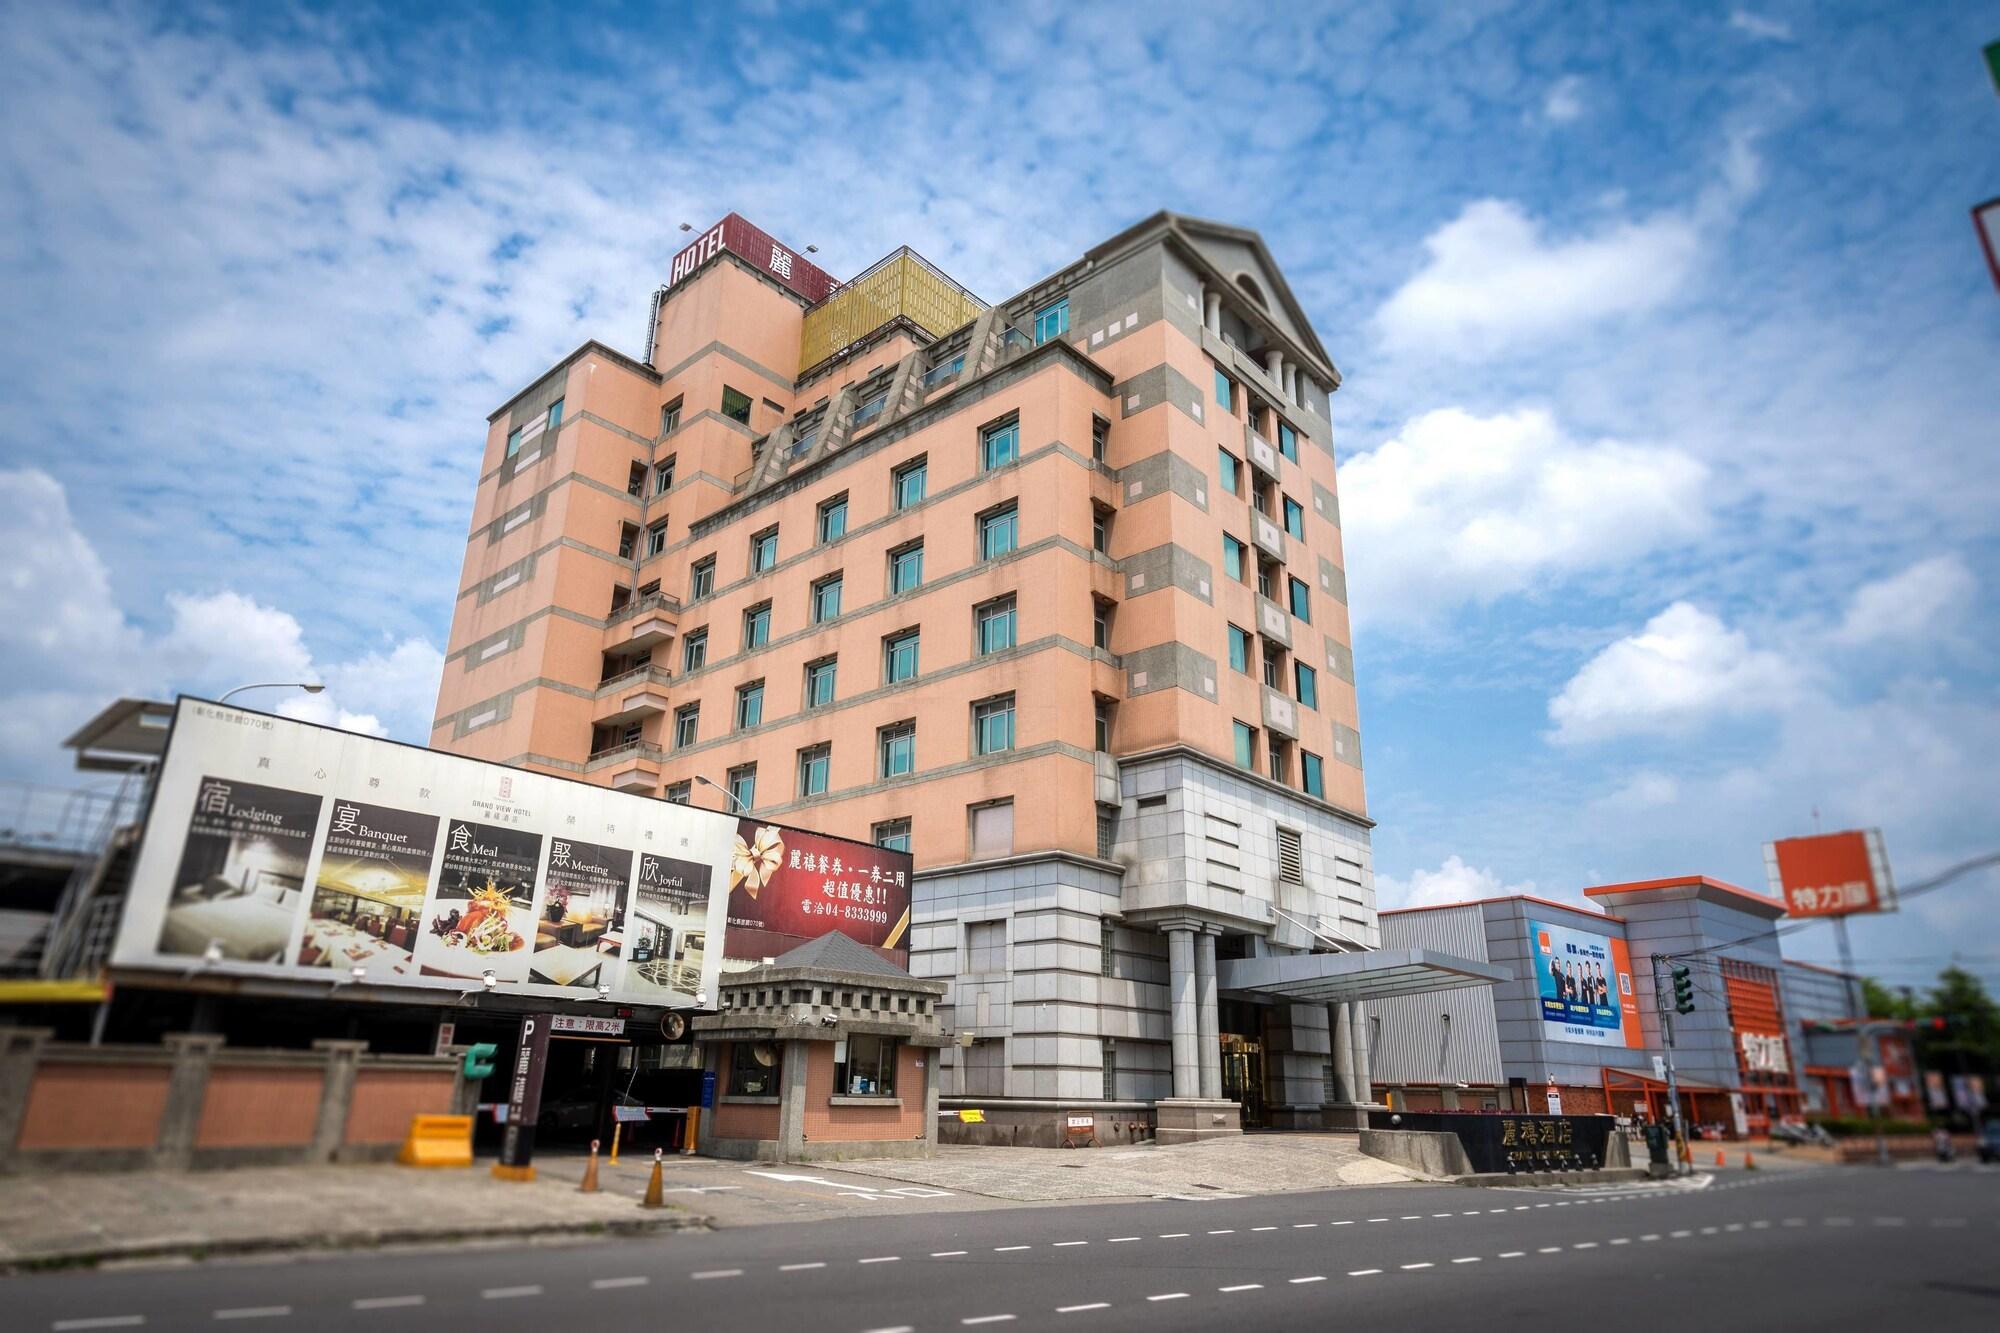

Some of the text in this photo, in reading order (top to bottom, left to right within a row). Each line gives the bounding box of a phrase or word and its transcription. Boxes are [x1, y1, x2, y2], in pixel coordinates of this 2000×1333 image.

[673, 223, 726, 285] HOTEL
[201, 781, 231, 814] 宿
[472, 800, 531, 817] GRAND VIEW HOTEL
[228, 803, 283, 825] Lodging
[332, 803, 360, 835] 宴
[359, 825, 408, 843] Banquet
[450, 824, 472, 853] 食
[472, 843, 498, 857] Meal
[551, 841, 571, 867] 聚
[571, 860, 609, 877] Meeting
[641, 857, 659, 883] 欣
[658, 874, 683, 888] Joyful
[522, 1020, 535, 1045] P
[554, 1017, 622, 1032] 注意：限高2米
[1502, 1119, 1573, 1147] 麗禧酒店
